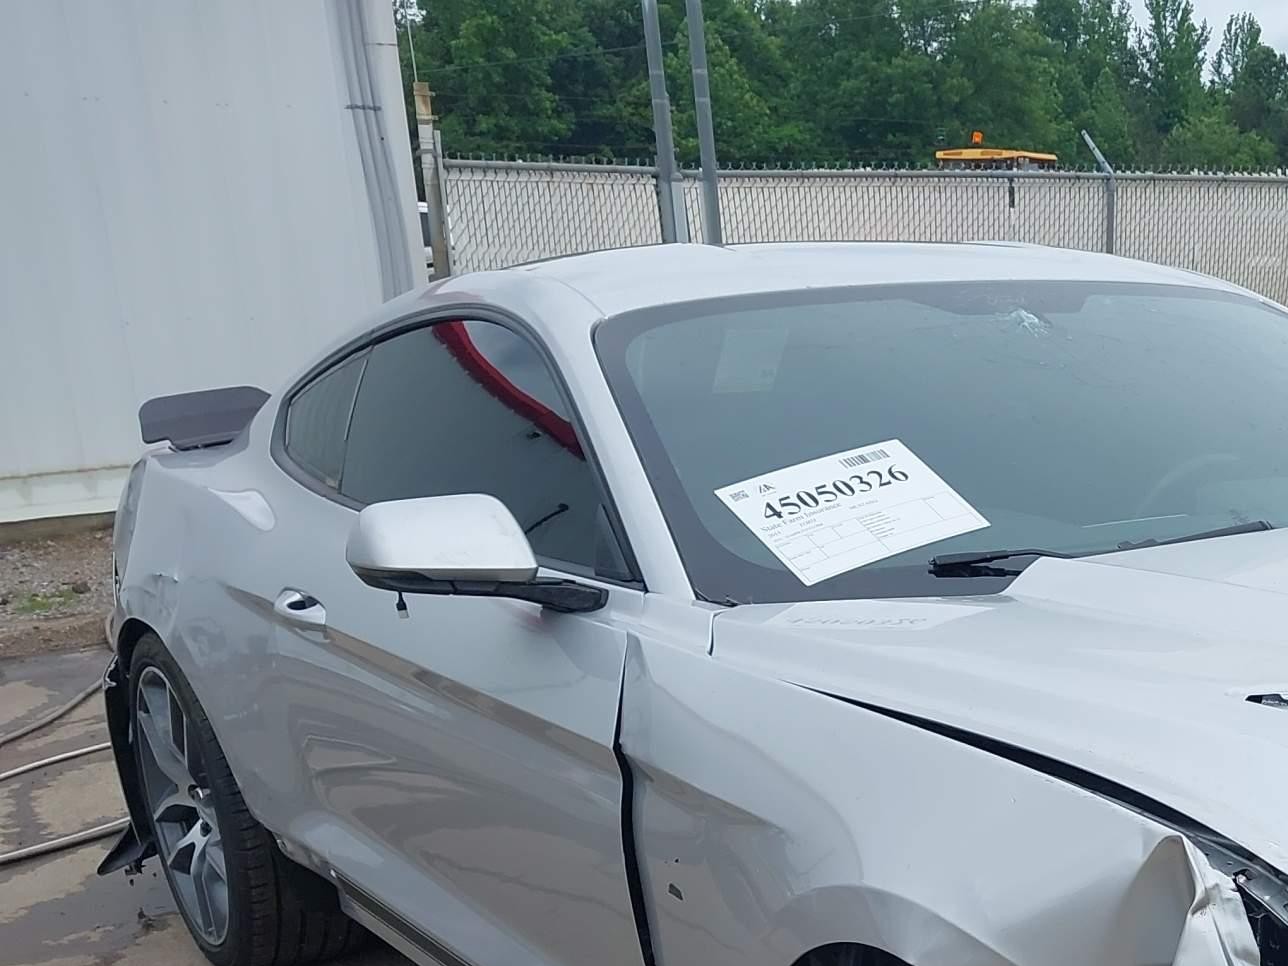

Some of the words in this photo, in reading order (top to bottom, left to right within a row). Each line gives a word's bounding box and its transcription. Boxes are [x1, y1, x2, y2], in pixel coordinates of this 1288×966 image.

[764, 464, 909, 519] 45050326
[761, 522, 781, 533] State
[783, 514, 804, 527] Farm
